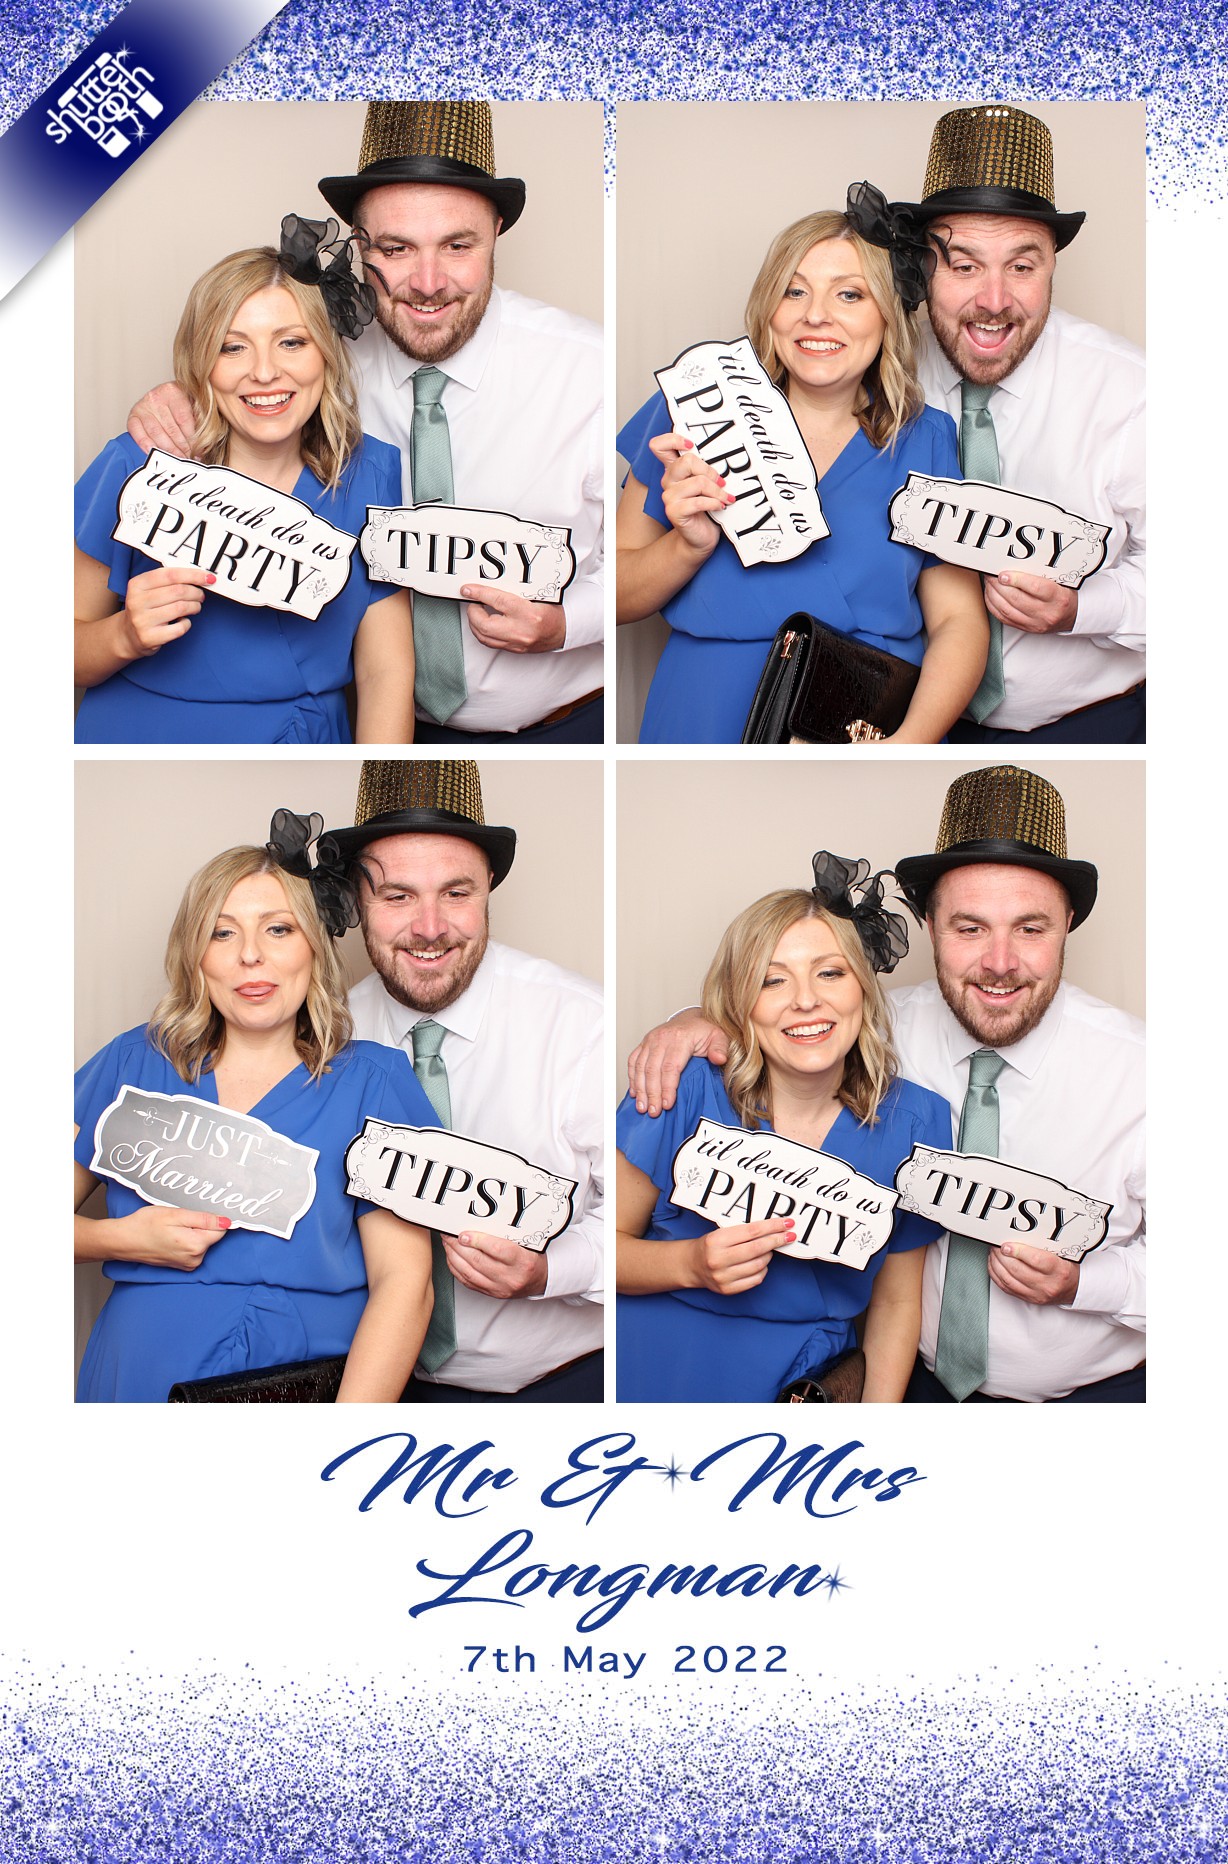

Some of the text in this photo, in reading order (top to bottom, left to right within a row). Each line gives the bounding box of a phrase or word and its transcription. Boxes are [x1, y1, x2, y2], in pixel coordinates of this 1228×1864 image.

[736, 394, 794, 465] death
[188, 486, 275, 530] death
[271, 520, 309, 545] do
[311, 540, 344, 561] us
[771, 473, 808, 505] do
[141, 502, 321, 605] PARTY
[387, 529, 549, 584] TIPSY
[789, 512, 813, 538] us
[921, 498, 1084, 569] TIPSY
[162, 1110, 264, 1167] JUST
[109, 1140, 284, 1218] Married
[378, 1146, 550, 1229] TIPSY
[736, 1150, 819, 1189] death
[816, 1178, 853, 1202] do
[855, 1198, 888, 1215] us
[926, 1169, 1087, 1242] TIPSY
